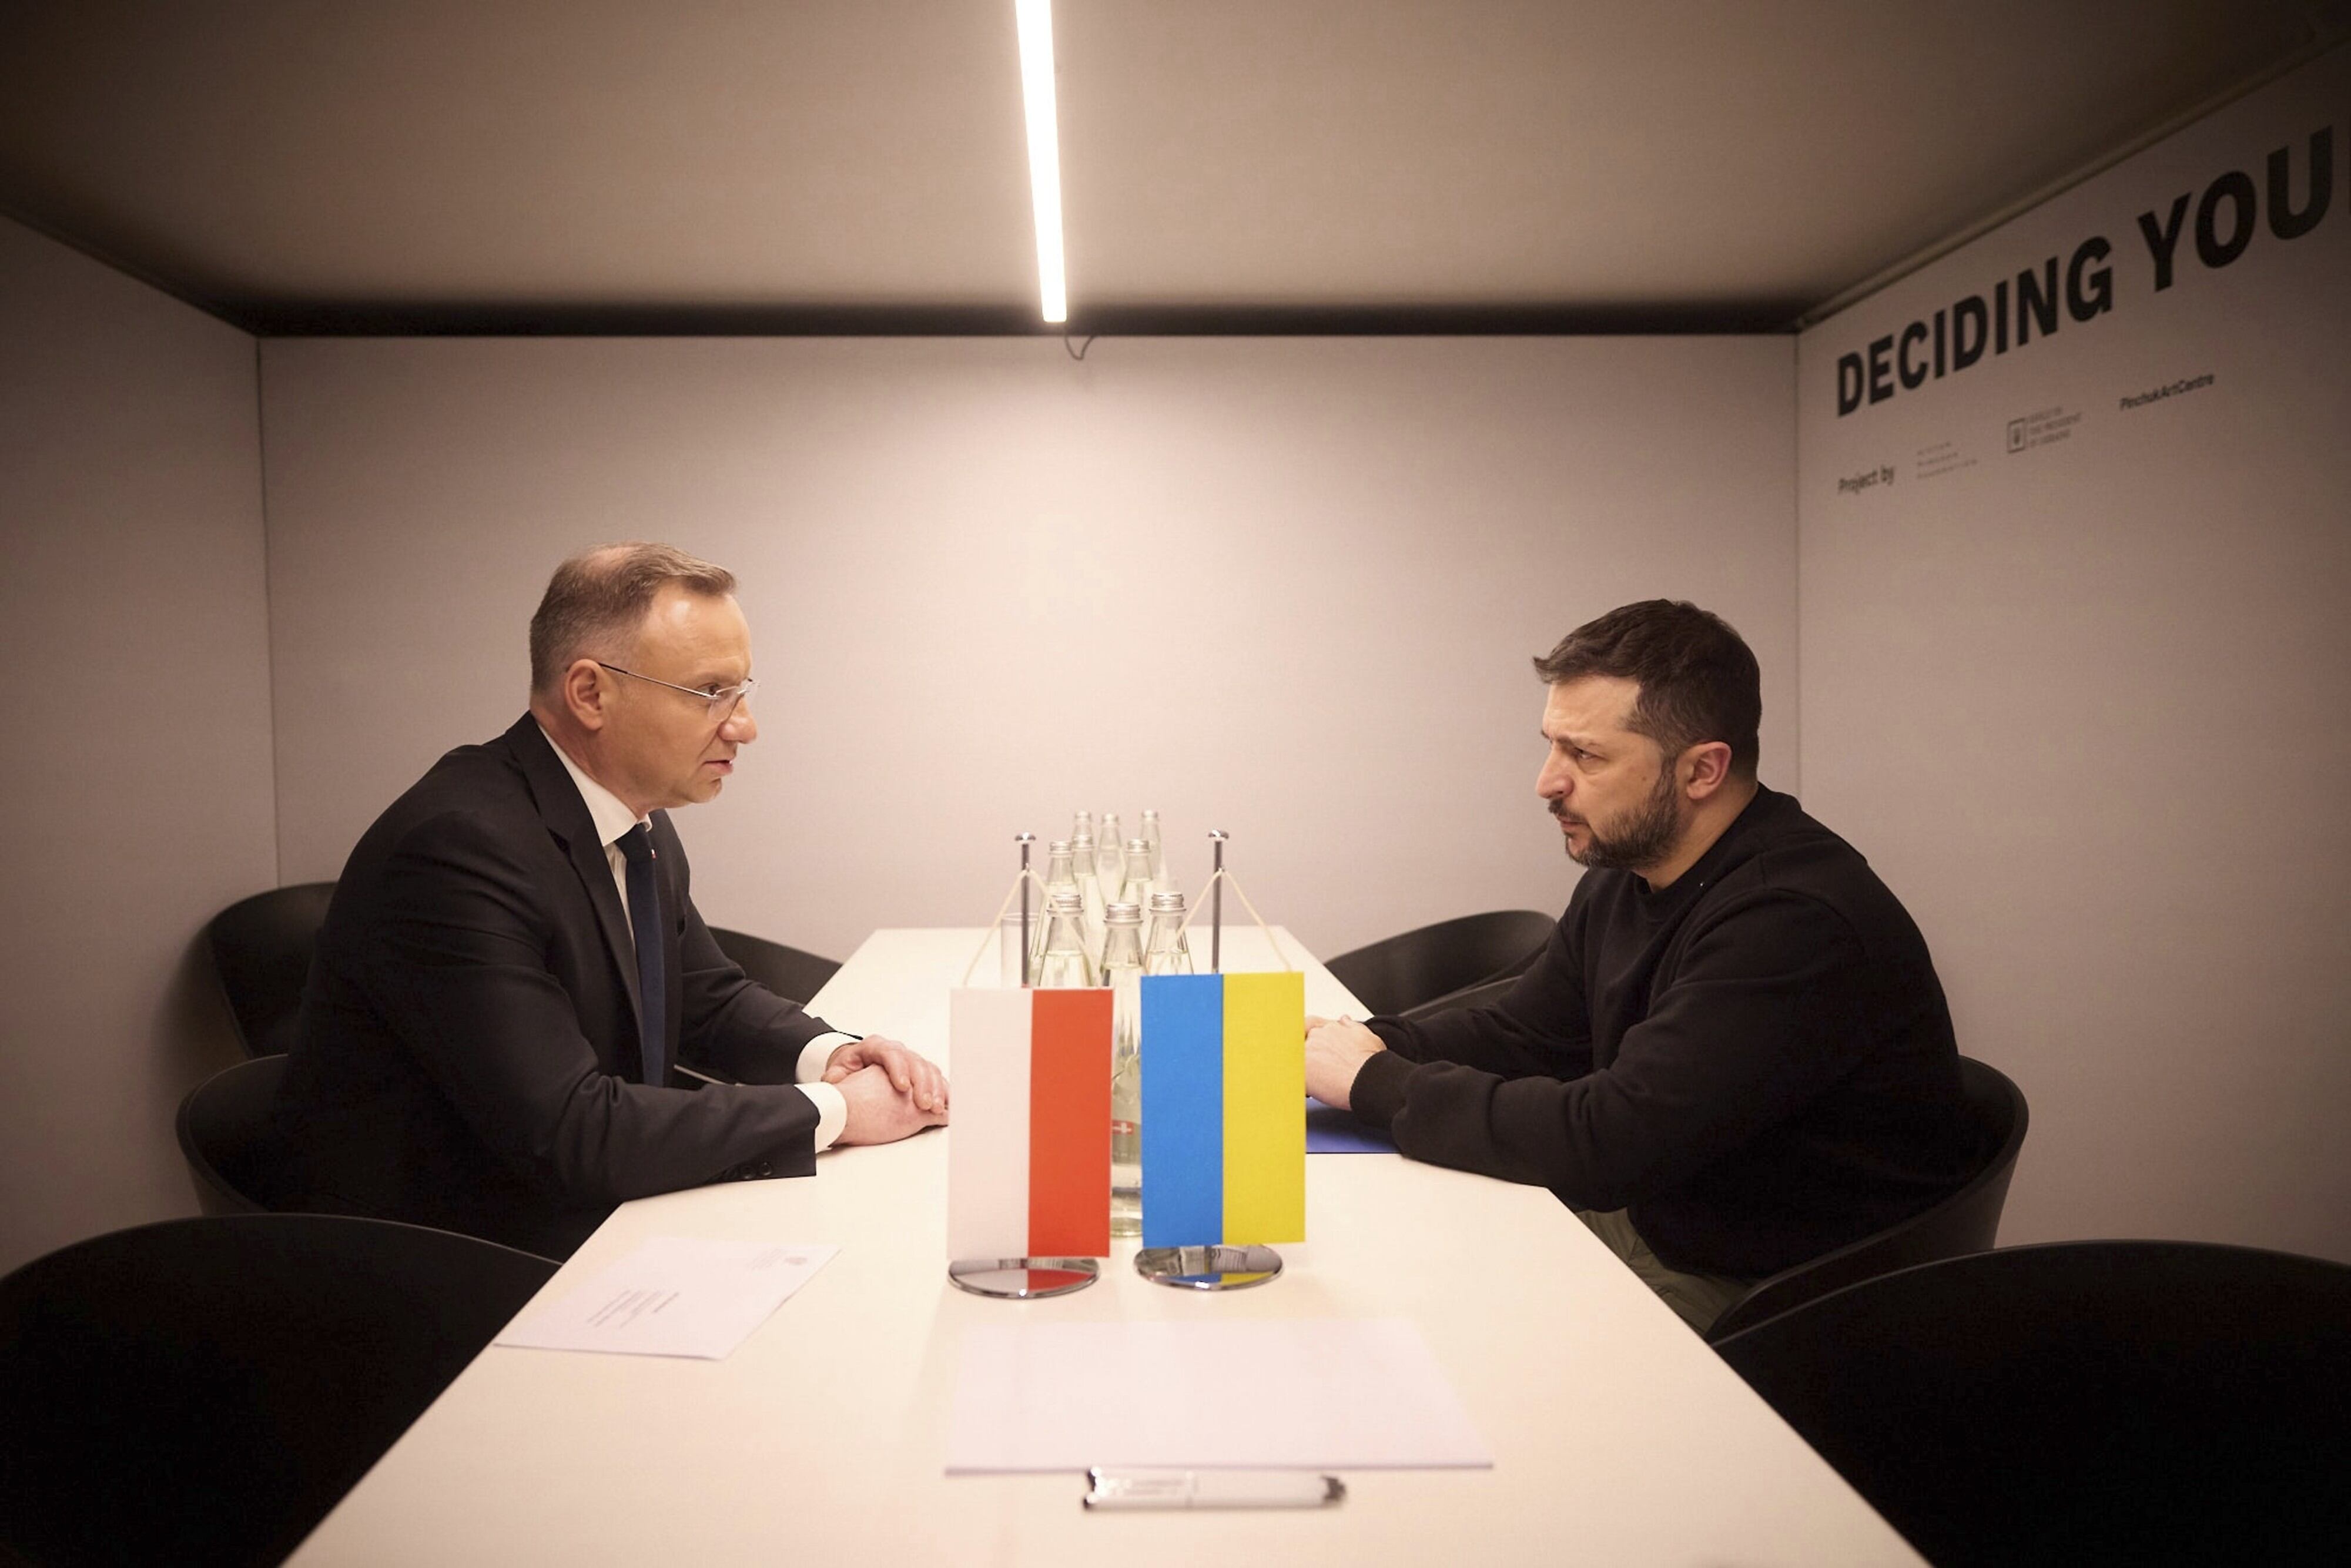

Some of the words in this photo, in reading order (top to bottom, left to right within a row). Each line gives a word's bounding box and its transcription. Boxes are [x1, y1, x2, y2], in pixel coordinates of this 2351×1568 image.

[1837, 236, 2114, 418] DECIDING
[2137, 118, 2351, 292] YOU
[1837, 470, 1878, 495] Project
[1880, 464, 1895, 486] by
